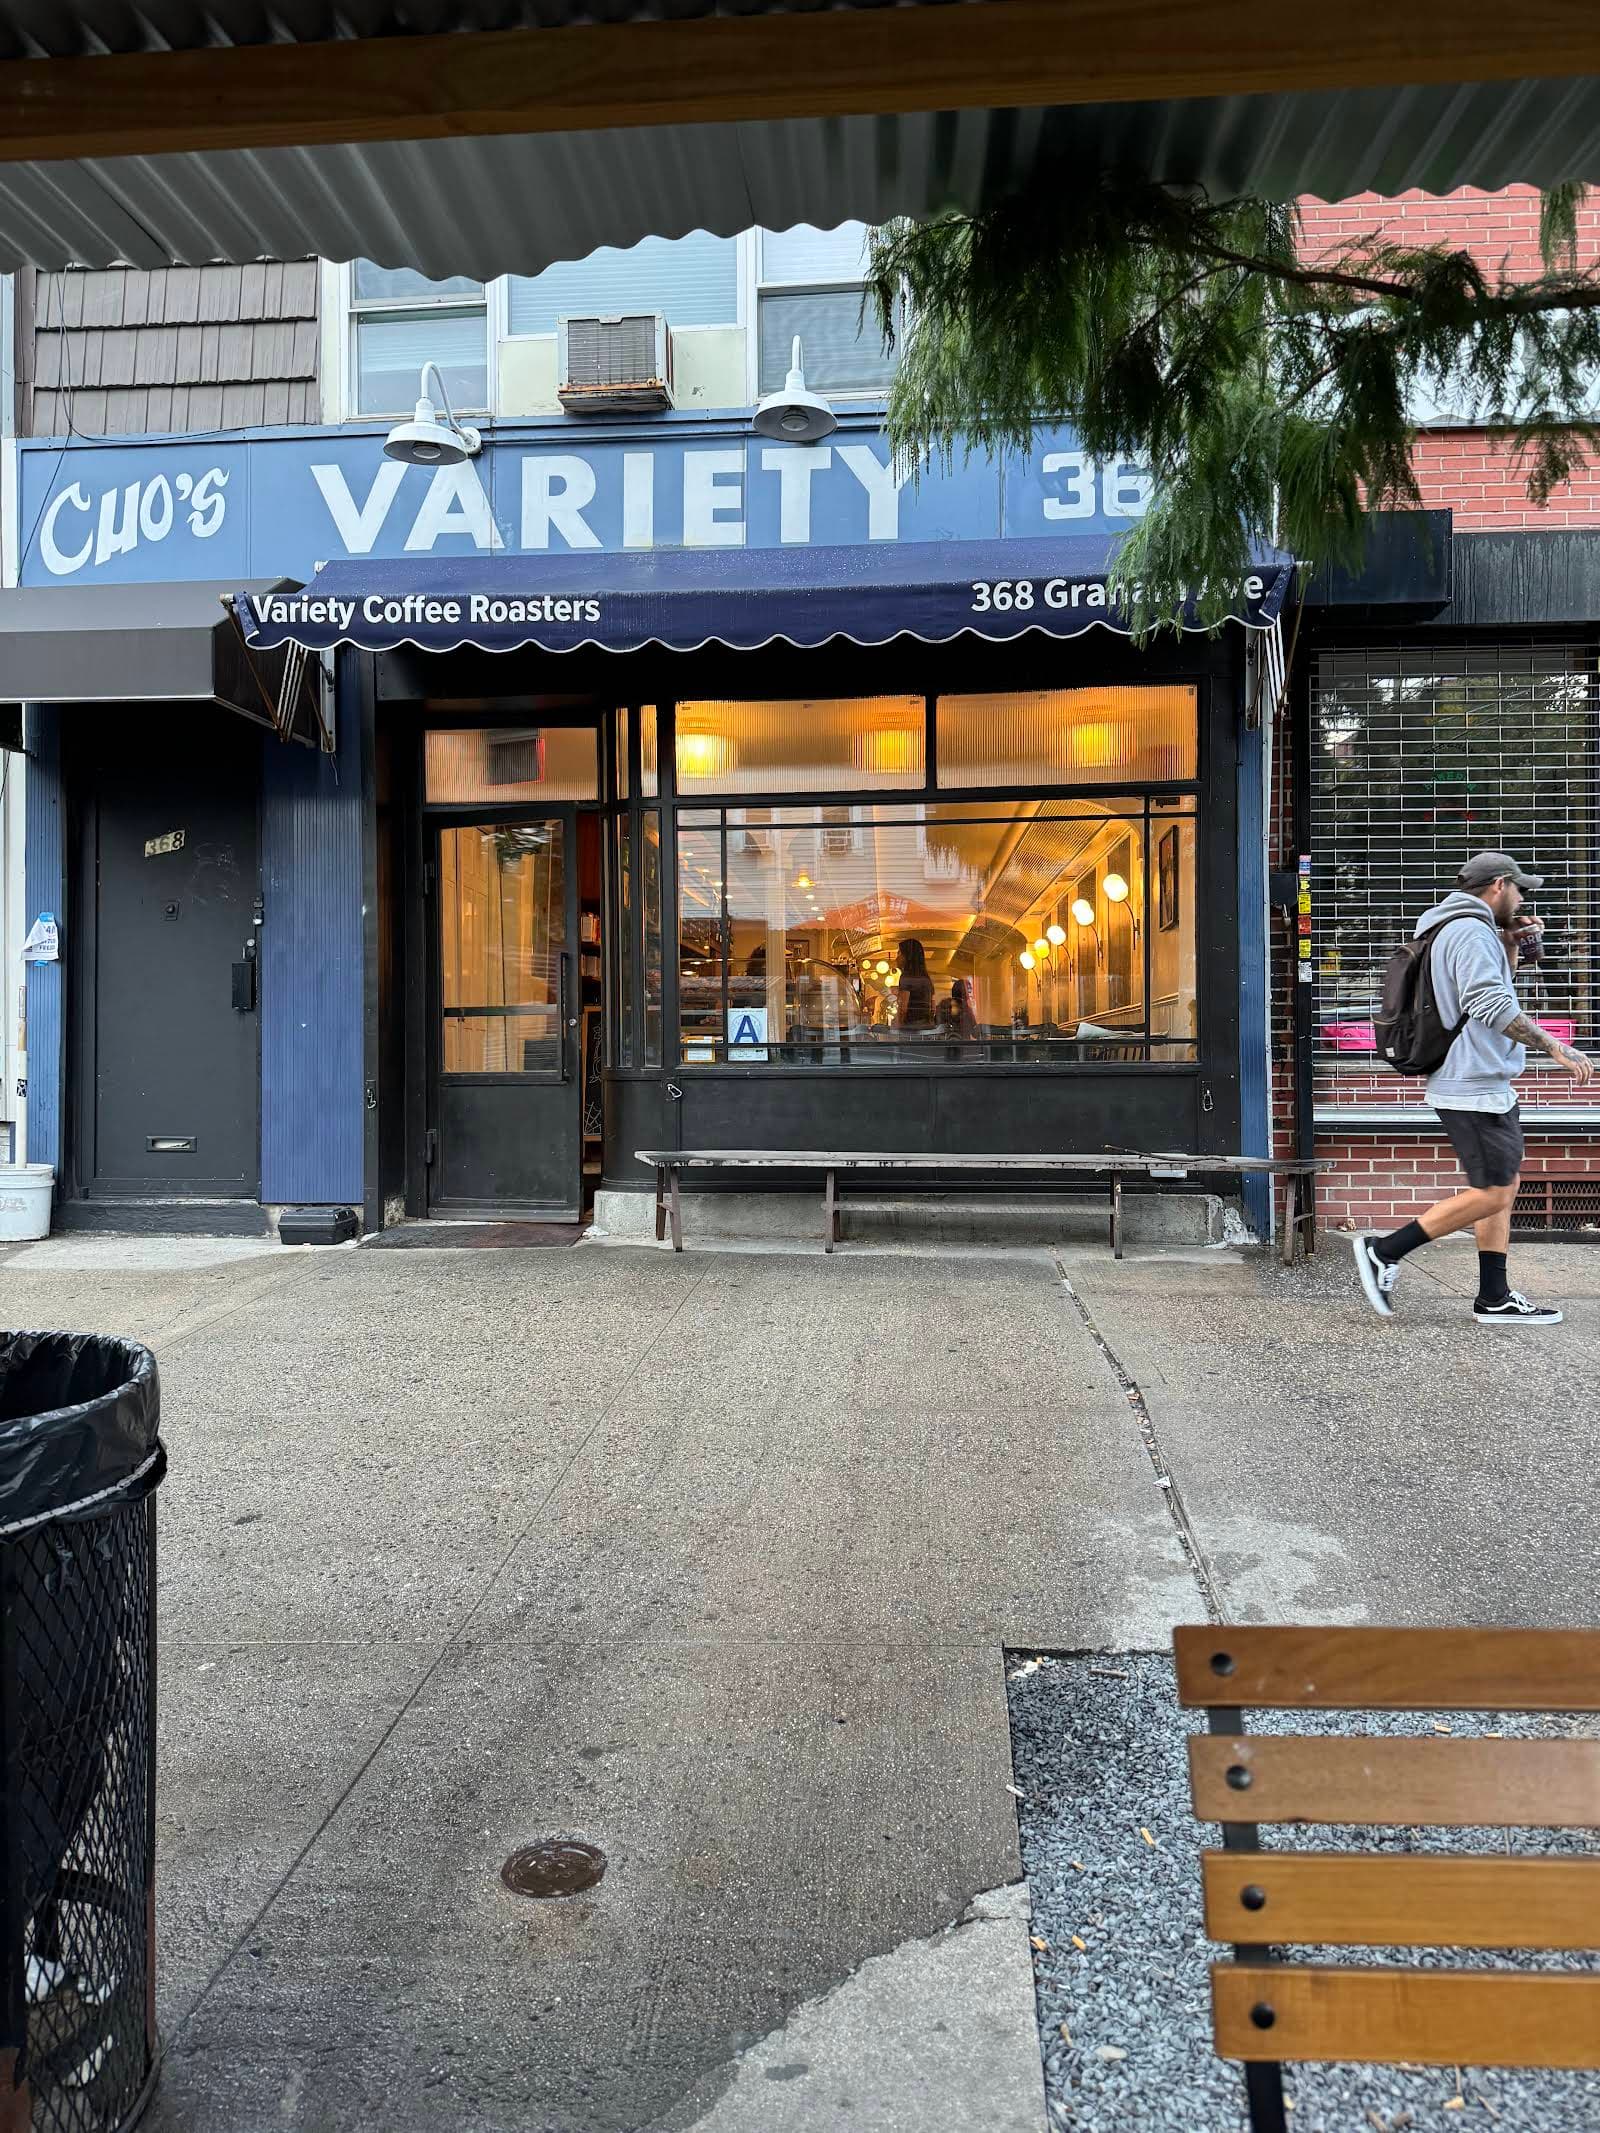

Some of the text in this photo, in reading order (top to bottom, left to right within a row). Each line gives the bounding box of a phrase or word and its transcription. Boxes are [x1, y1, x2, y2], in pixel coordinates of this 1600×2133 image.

[310, 444, 935, 554] VARIETY
[1043, 451, 1192, 520] 36
[252, 594, 601, 631] Variety Coffee Roasters
[971, 580, 1035, 612] 368
[146, 832, 183, 855] 368
[734, 1015, 760, 1044] A
